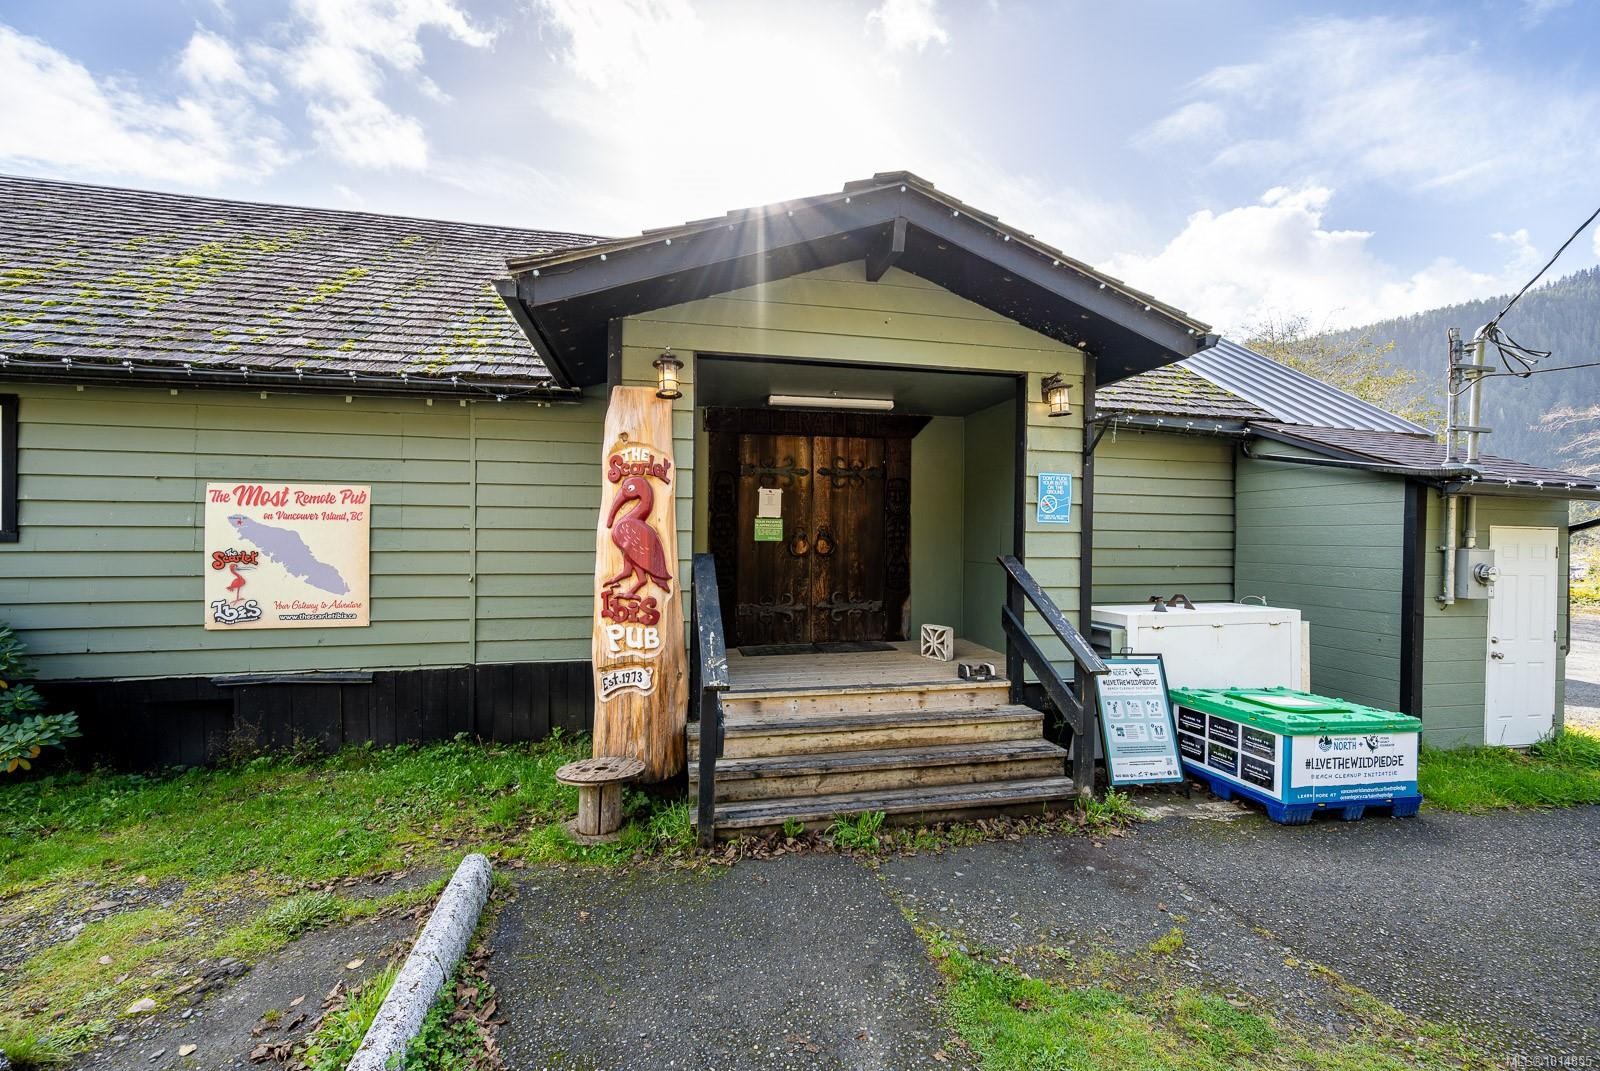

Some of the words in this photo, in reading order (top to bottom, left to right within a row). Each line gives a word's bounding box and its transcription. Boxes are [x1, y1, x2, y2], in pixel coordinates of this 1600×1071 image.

[622, 448, 650, 462] THE
[608, 455, 671, 485] Scarlet
[209, 489, 231, 503] The
[233, 485, 289, 507] Most
[294, 490, 337, 506] Remote
[340, 489, 367, 505] Pub
[263, 512, 273, 520] on
[276, 511, 319, 521] Vancouver
[321, 512, 349, 522] Island,
[350, 512, 363, 522] BC
[224, 548, 238, 556] The
[212, 550, 258, 570] Scarlet
[273, 600, 290, 610] Your
[292, 600, 318, 613] Gateway
[320, 602, 328, 610] to
[328, 600, 363, 609] Adventure
[279, 612, 357, 621] www.thescarletibis.ca
[606, 624, 660, 652] PUB
[602, 671, 643, 691] Est.1973
[1334, 742, 1356, 751] NORTH
[1305, 755, 1404, 770] #LIVETHEWILDPLEDGE
